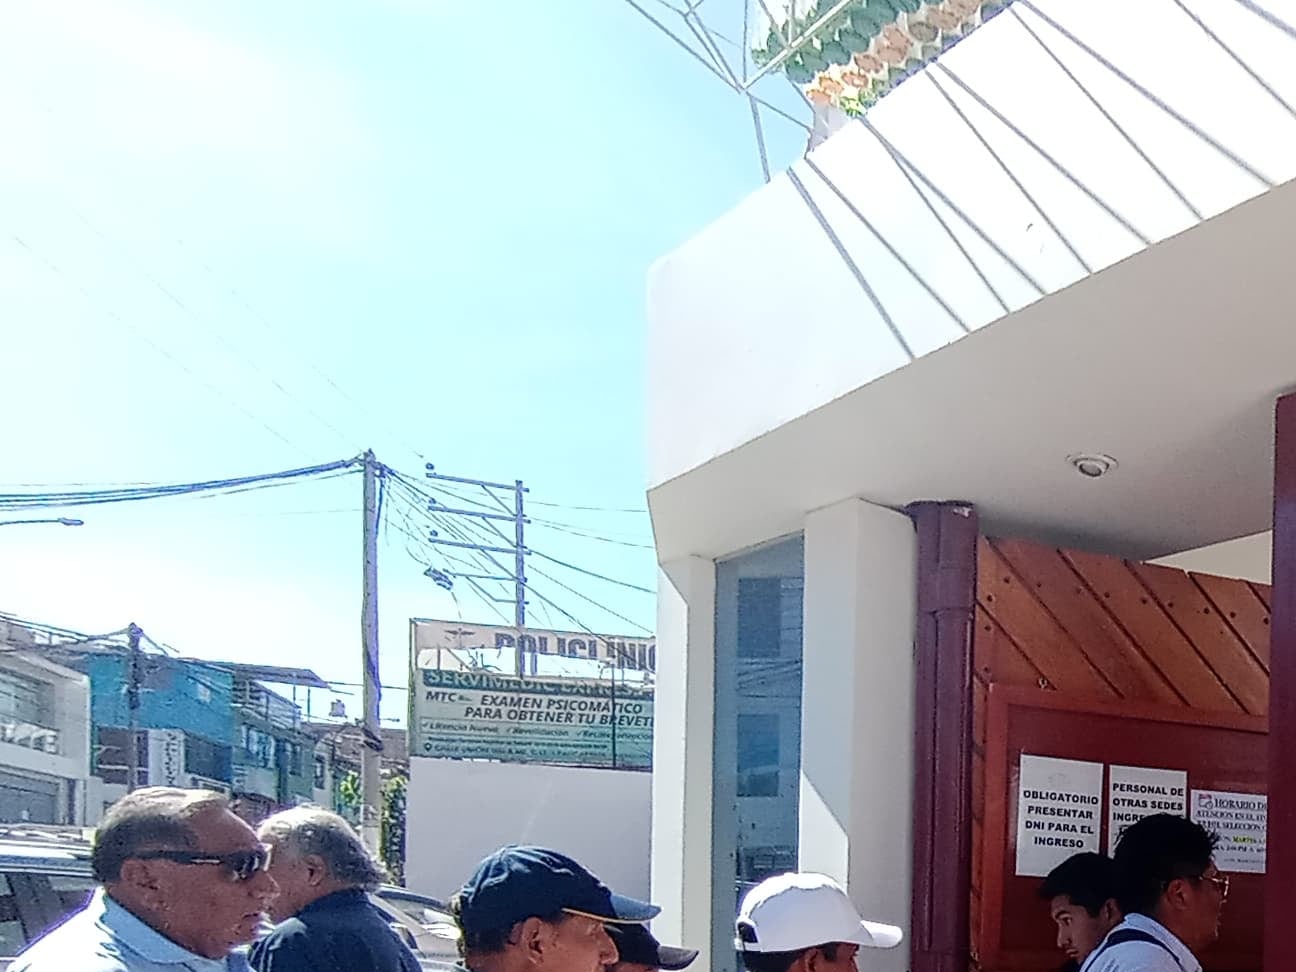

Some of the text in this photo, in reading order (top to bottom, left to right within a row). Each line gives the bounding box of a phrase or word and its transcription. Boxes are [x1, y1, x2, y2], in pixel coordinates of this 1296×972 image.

[425, 691, 458, 703] MTC
[481, 694, 543, 709] EXAMEN
[464, 706, 503, 719] PARA
[506, 708, 574, 724] OBTENER
[579, 713, 596, 725] TU
[1112, 783, 1184, 797] PERSONAL DE
[1023, 790, 1099, 805] OBLIGATORIO
[1112, 798, 1184, 811] OTRAS SEDES
[1214, 799, 1256, 809] HORARIO
[1027, 805, 1093, 819] PRESENTAR
[1025, 820, 1094, 834] DNI PARA EL
[1034, 836, 1084, 848] INGRESO
